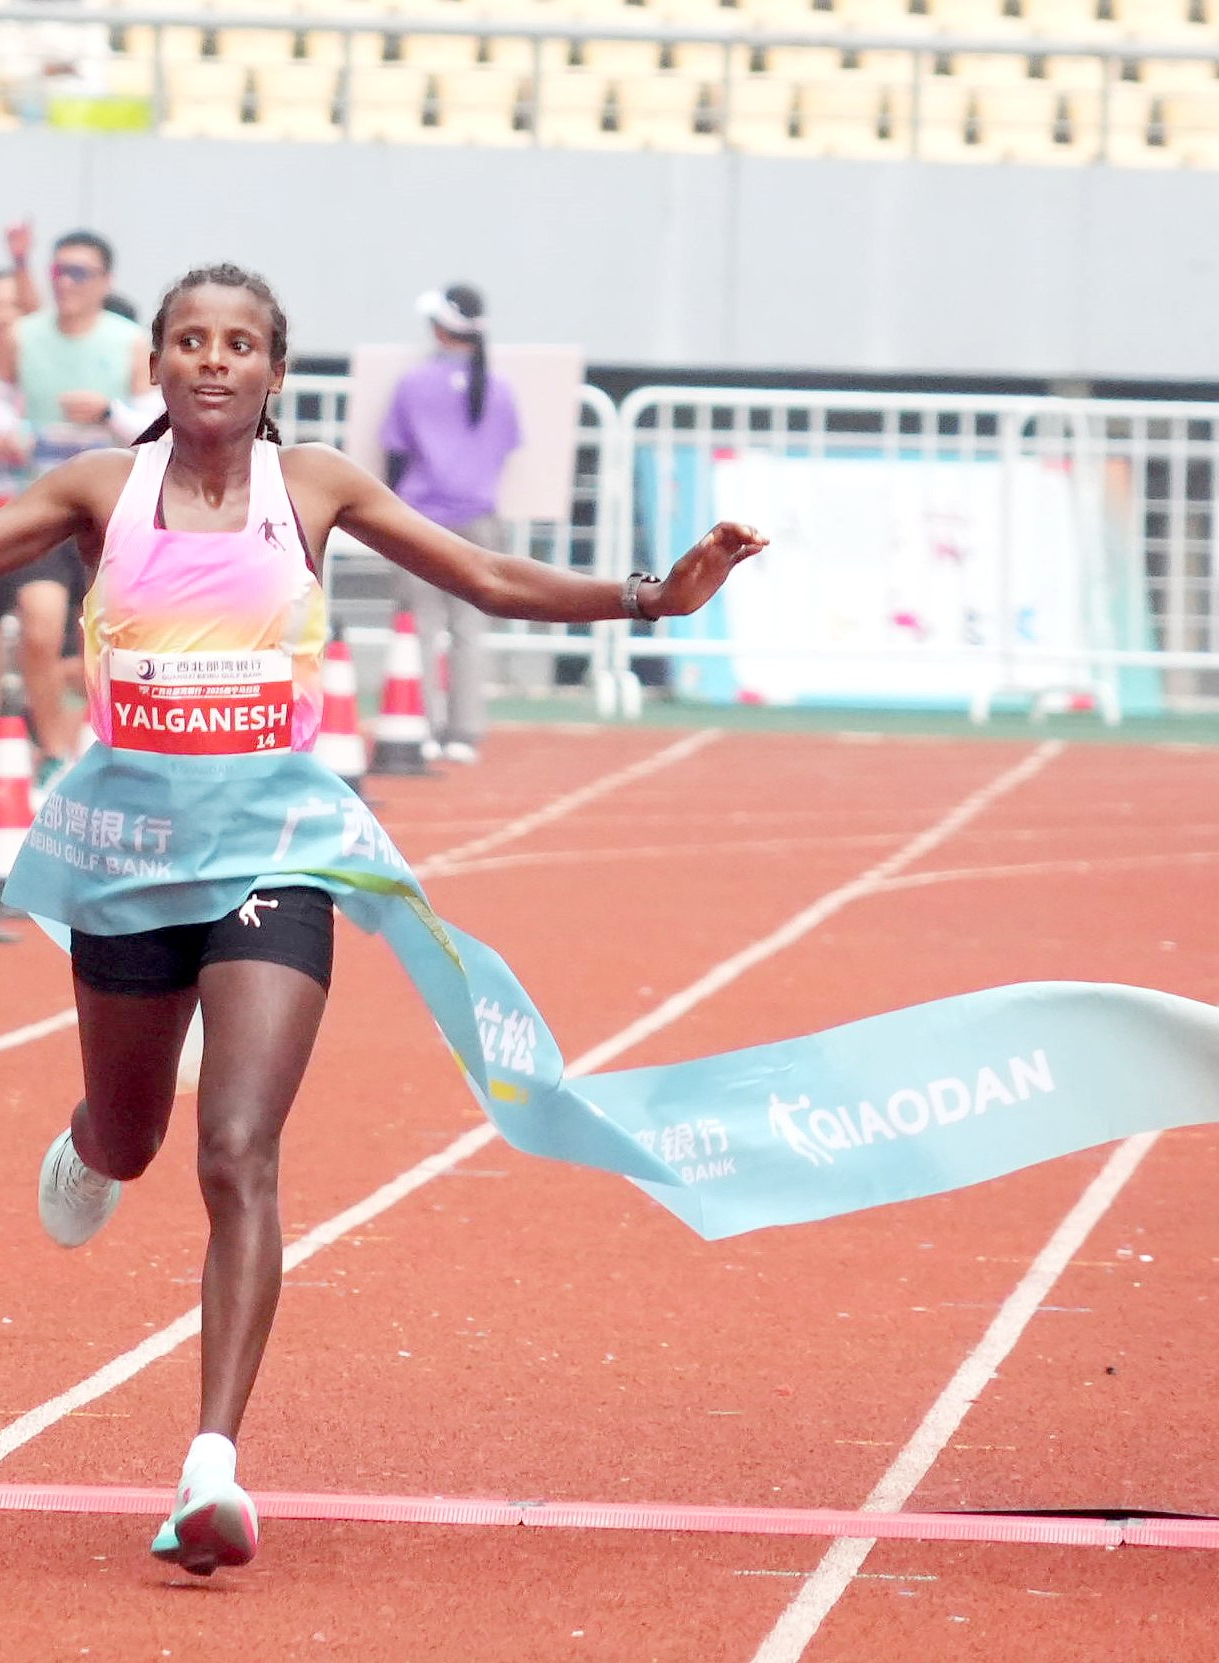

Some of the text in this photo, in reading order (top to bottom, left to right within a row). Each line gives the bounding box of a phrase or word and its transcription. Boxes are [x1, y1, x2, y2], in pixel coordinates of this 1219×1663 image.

[161, 658, 262, 673] 广西北部湾银行
[114, 702, 288, 733] YALGANESH
[256, 732, 276, 749] 14
[64, 843, 100, 871] GULF
[105, 856, 173, 879] BANK
[808, 1048, 1056, 1151] QIAODAN
[680, 1155, 737, 1184] BANK
